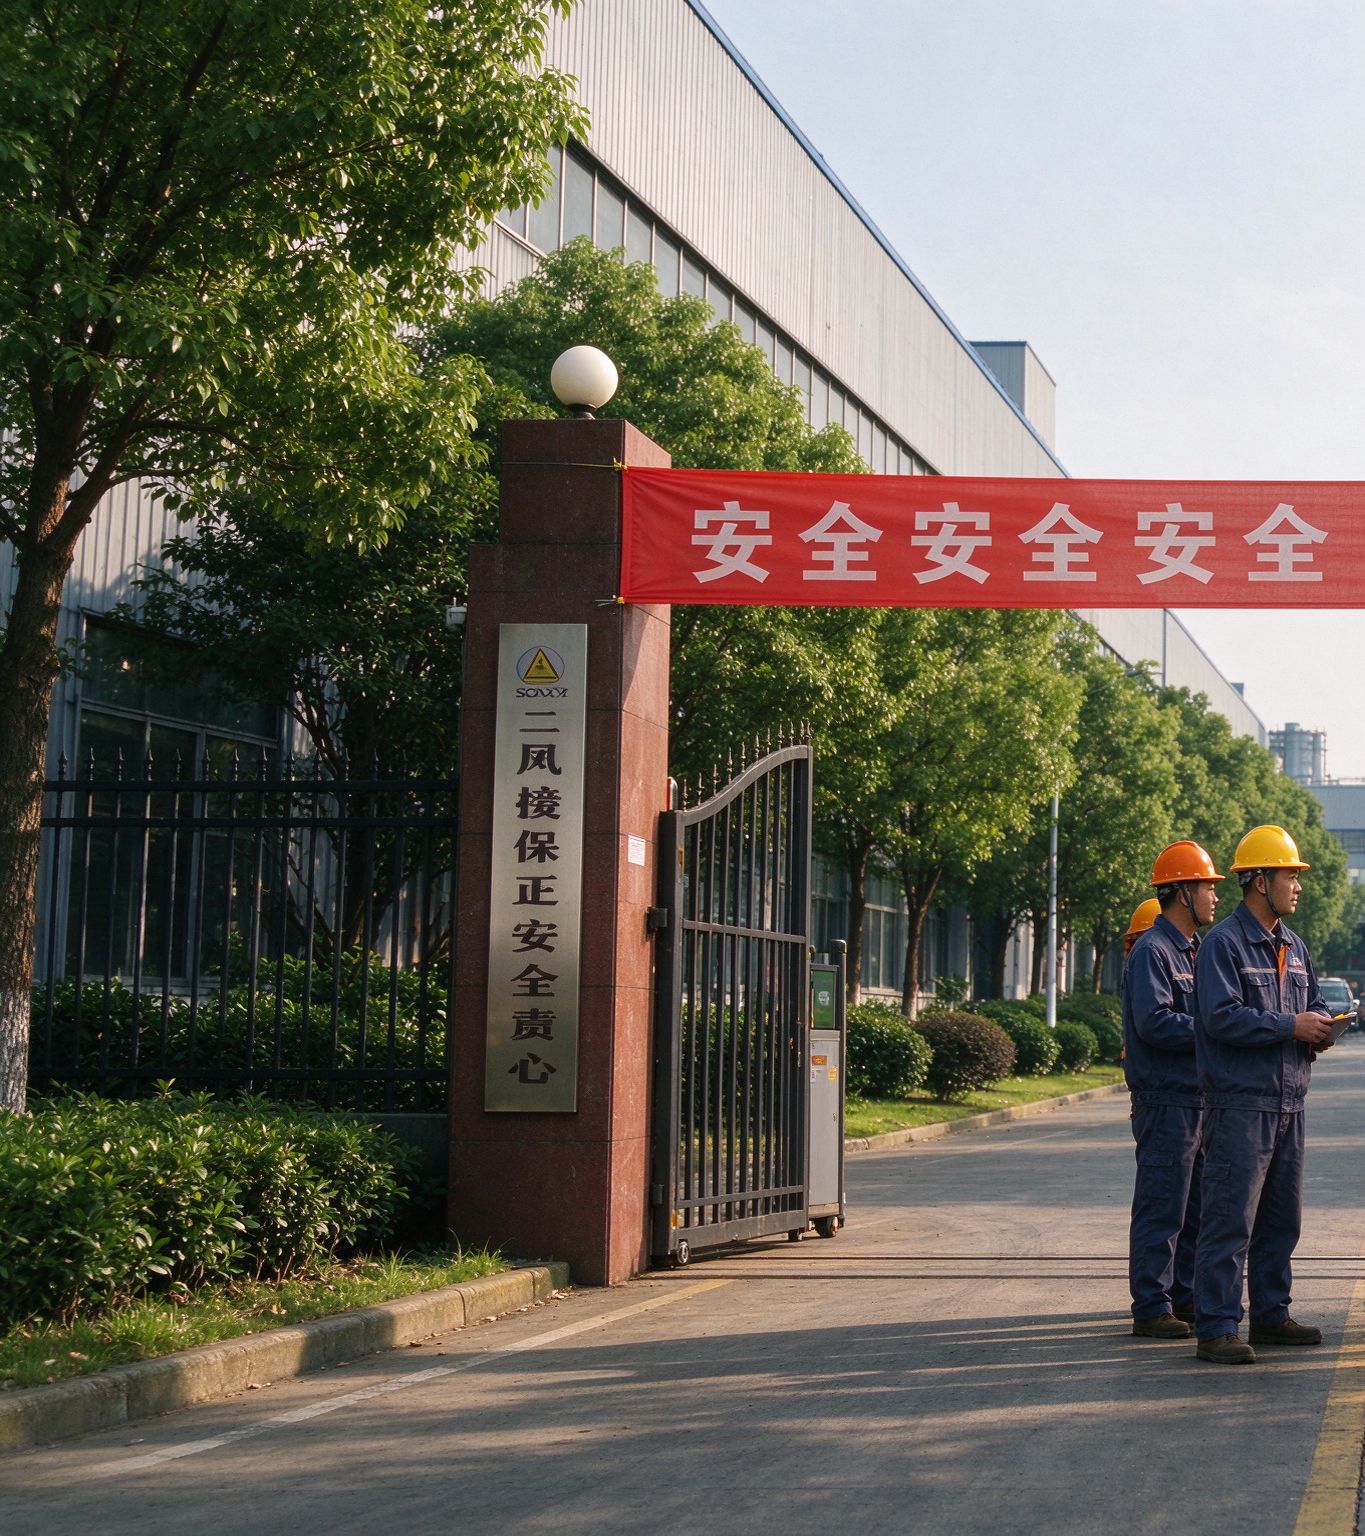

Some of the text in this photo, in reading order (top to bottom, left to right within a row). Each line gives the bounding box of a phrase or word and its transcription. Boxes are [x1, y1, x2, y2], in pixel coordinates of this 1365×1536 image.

[691, 500, 1329, 584] 安全安全安全
